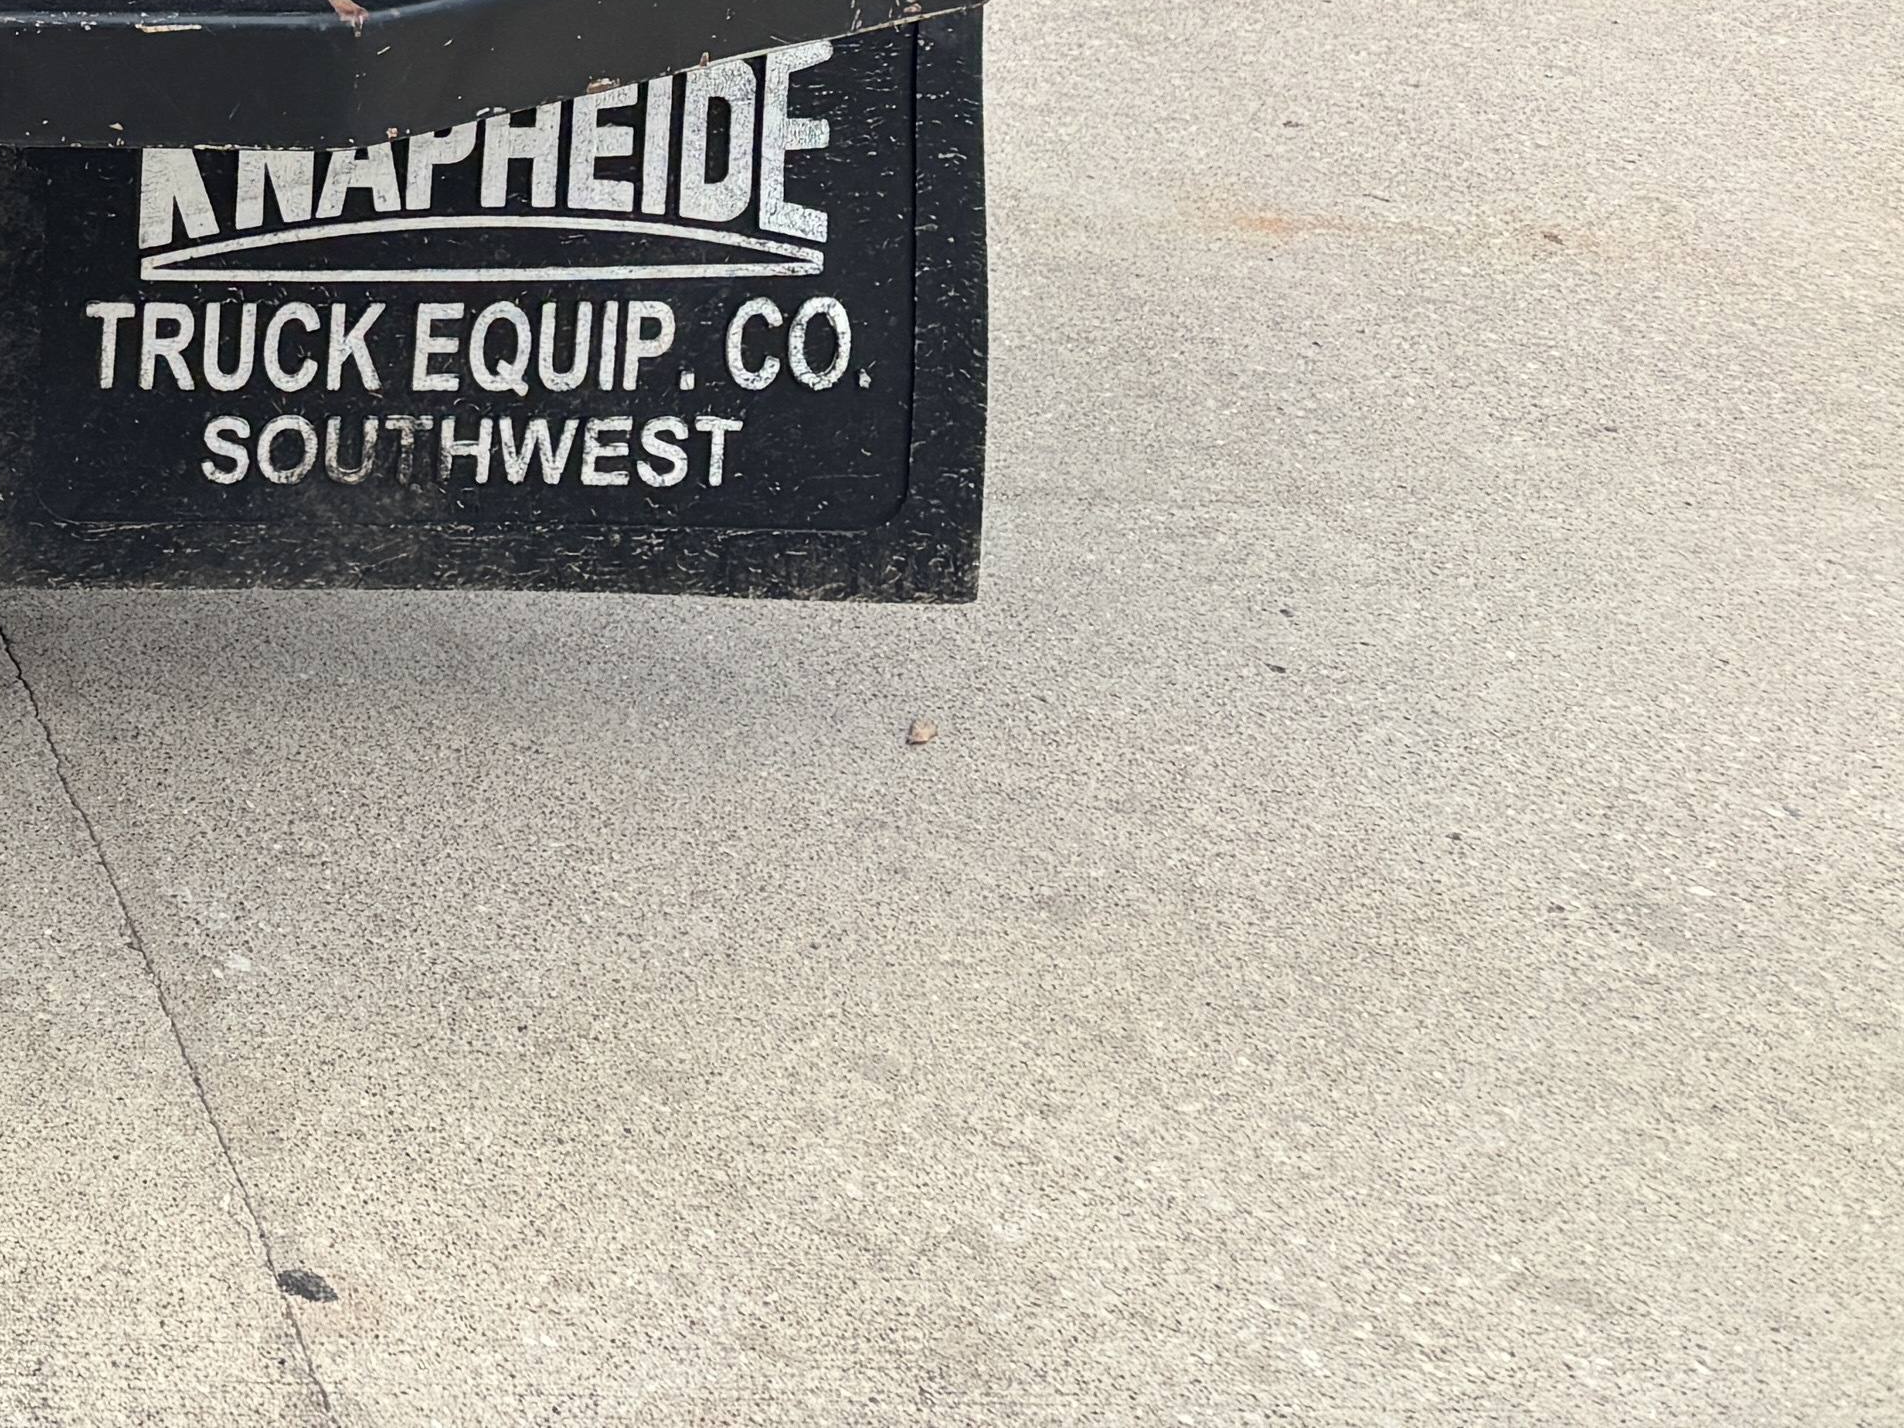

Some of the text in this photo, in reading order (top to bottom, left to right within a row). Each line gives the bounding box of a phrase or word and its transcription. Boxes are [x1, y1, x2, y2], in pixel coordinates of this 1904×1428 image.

[86, 295, 873, 397] TRUCK EQUIP. CO.
[200, 413, 744, 488] SOUTHWEST
